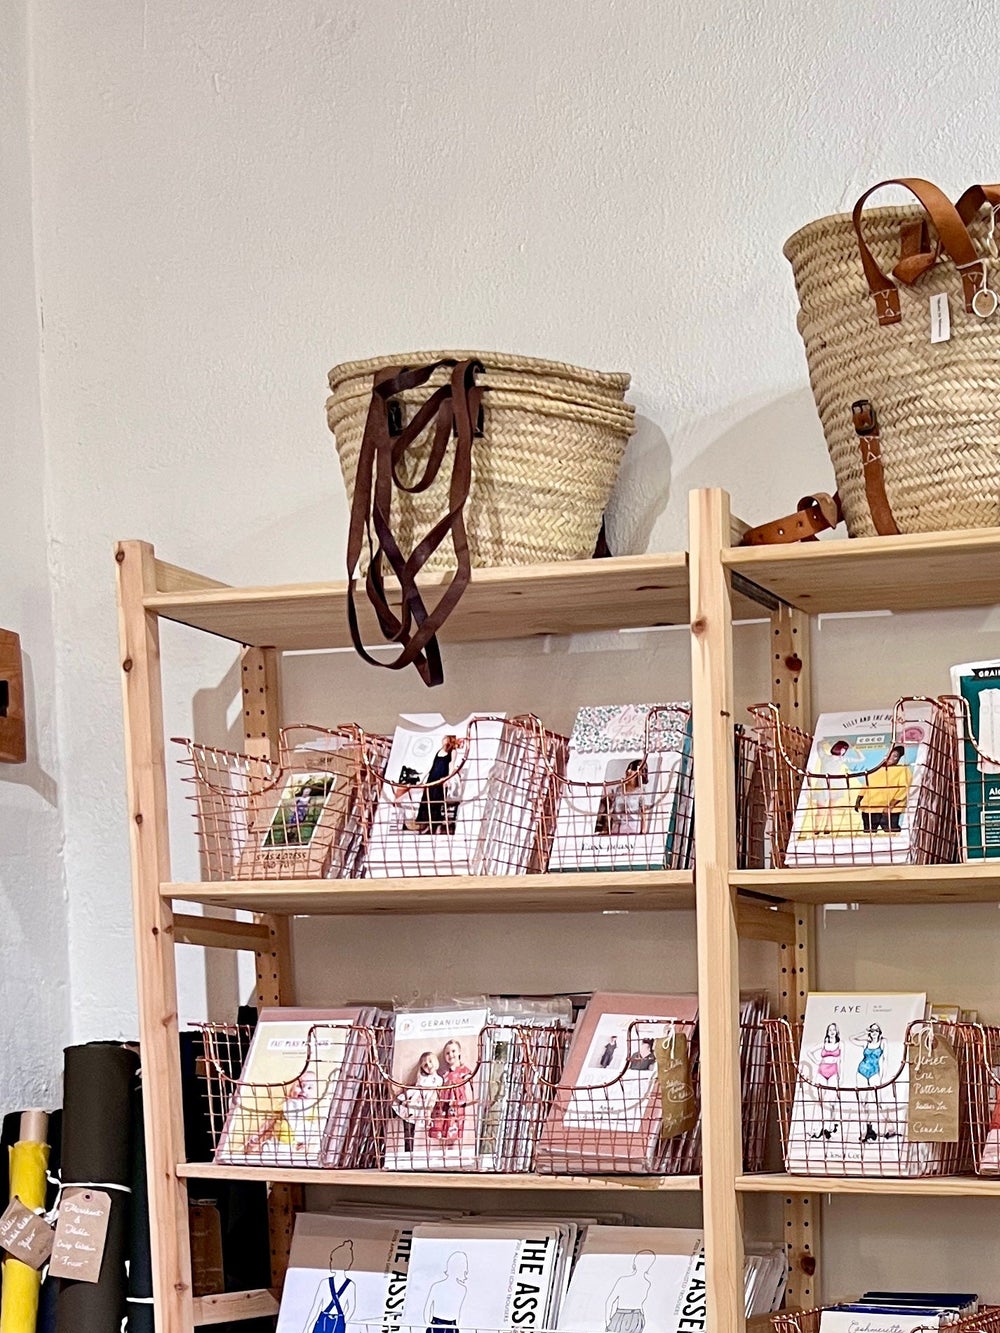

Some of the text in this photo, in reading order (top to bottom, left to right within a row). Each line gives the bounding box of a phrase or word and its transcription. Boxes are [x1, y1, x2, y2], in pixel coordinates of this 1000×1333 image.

[833, 1005, 861, 1014] FAYE
[421, 1018, 470, 1029] GERANIUM
[913, 1083, 953, 1094] Patterns
[519, 1237, 550, 1275] THE
[503, 1251, 518, 1323] ALMOST LONG TROUSERS
